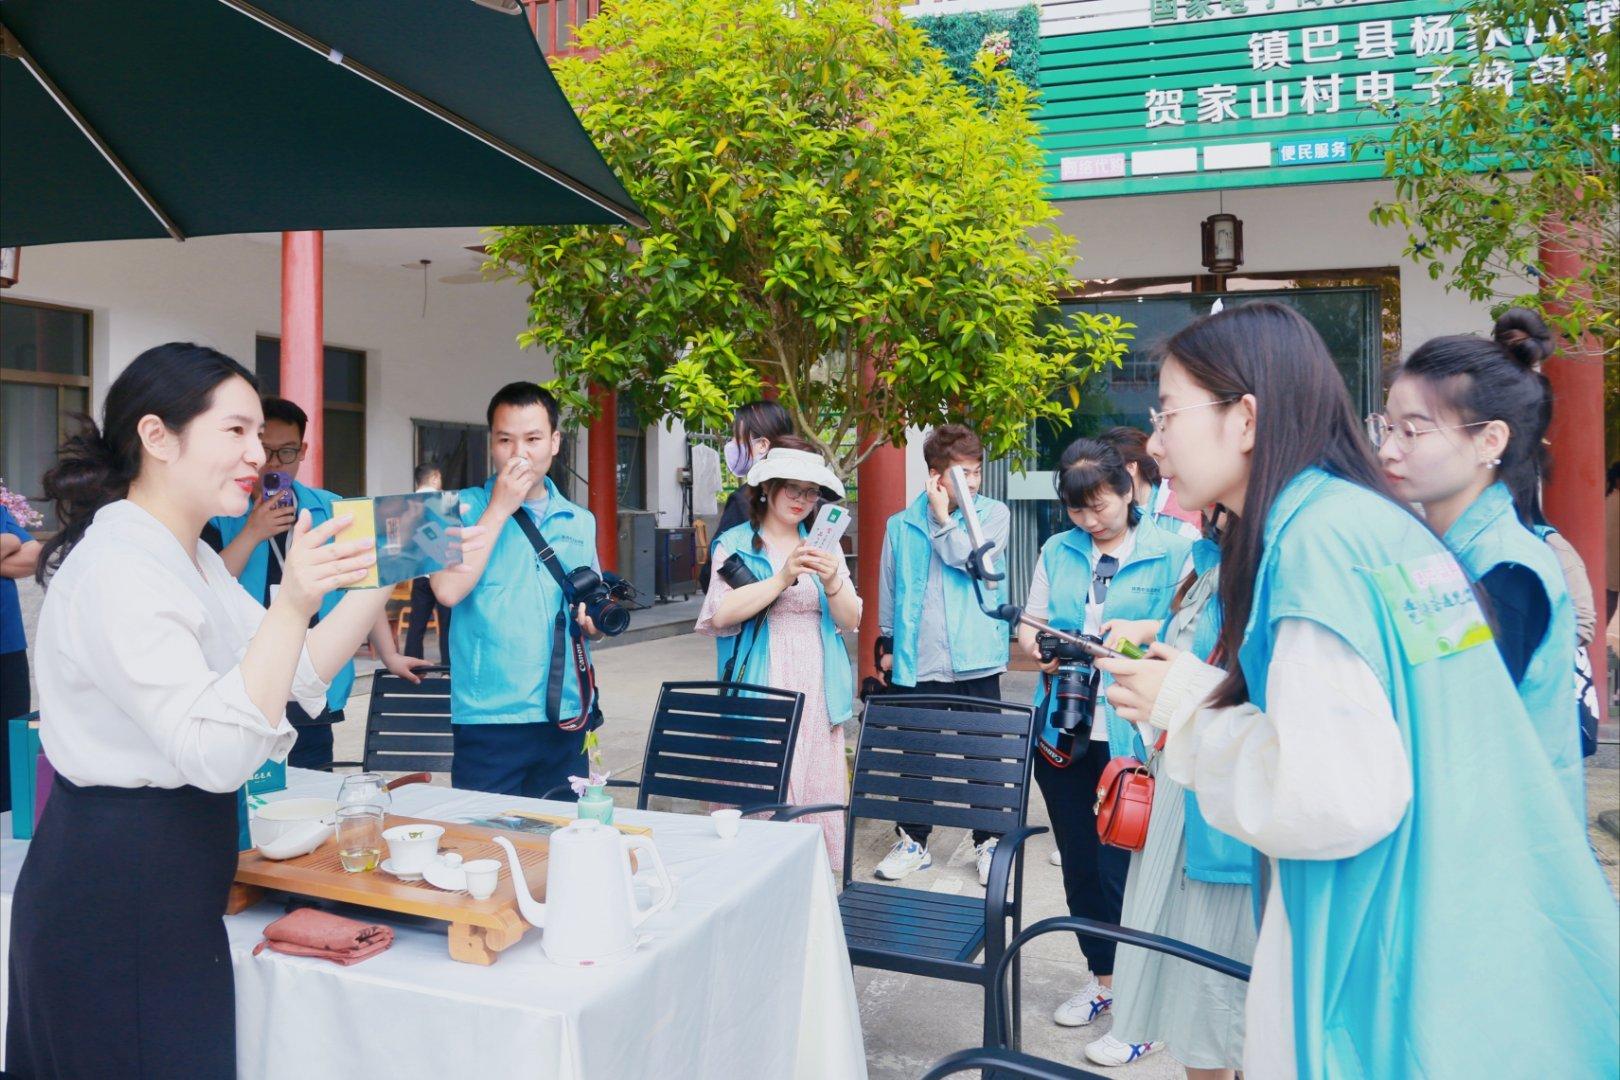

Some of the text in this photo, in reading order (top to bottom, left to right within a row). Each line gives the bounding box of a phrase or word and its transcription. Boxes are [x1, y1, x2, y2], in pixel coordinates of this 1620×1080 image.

[1281, 142, 1347, 162] 便民服务
[576, 643, 587, 672] Canon
[1039, 741, 1063, 763] Canon
